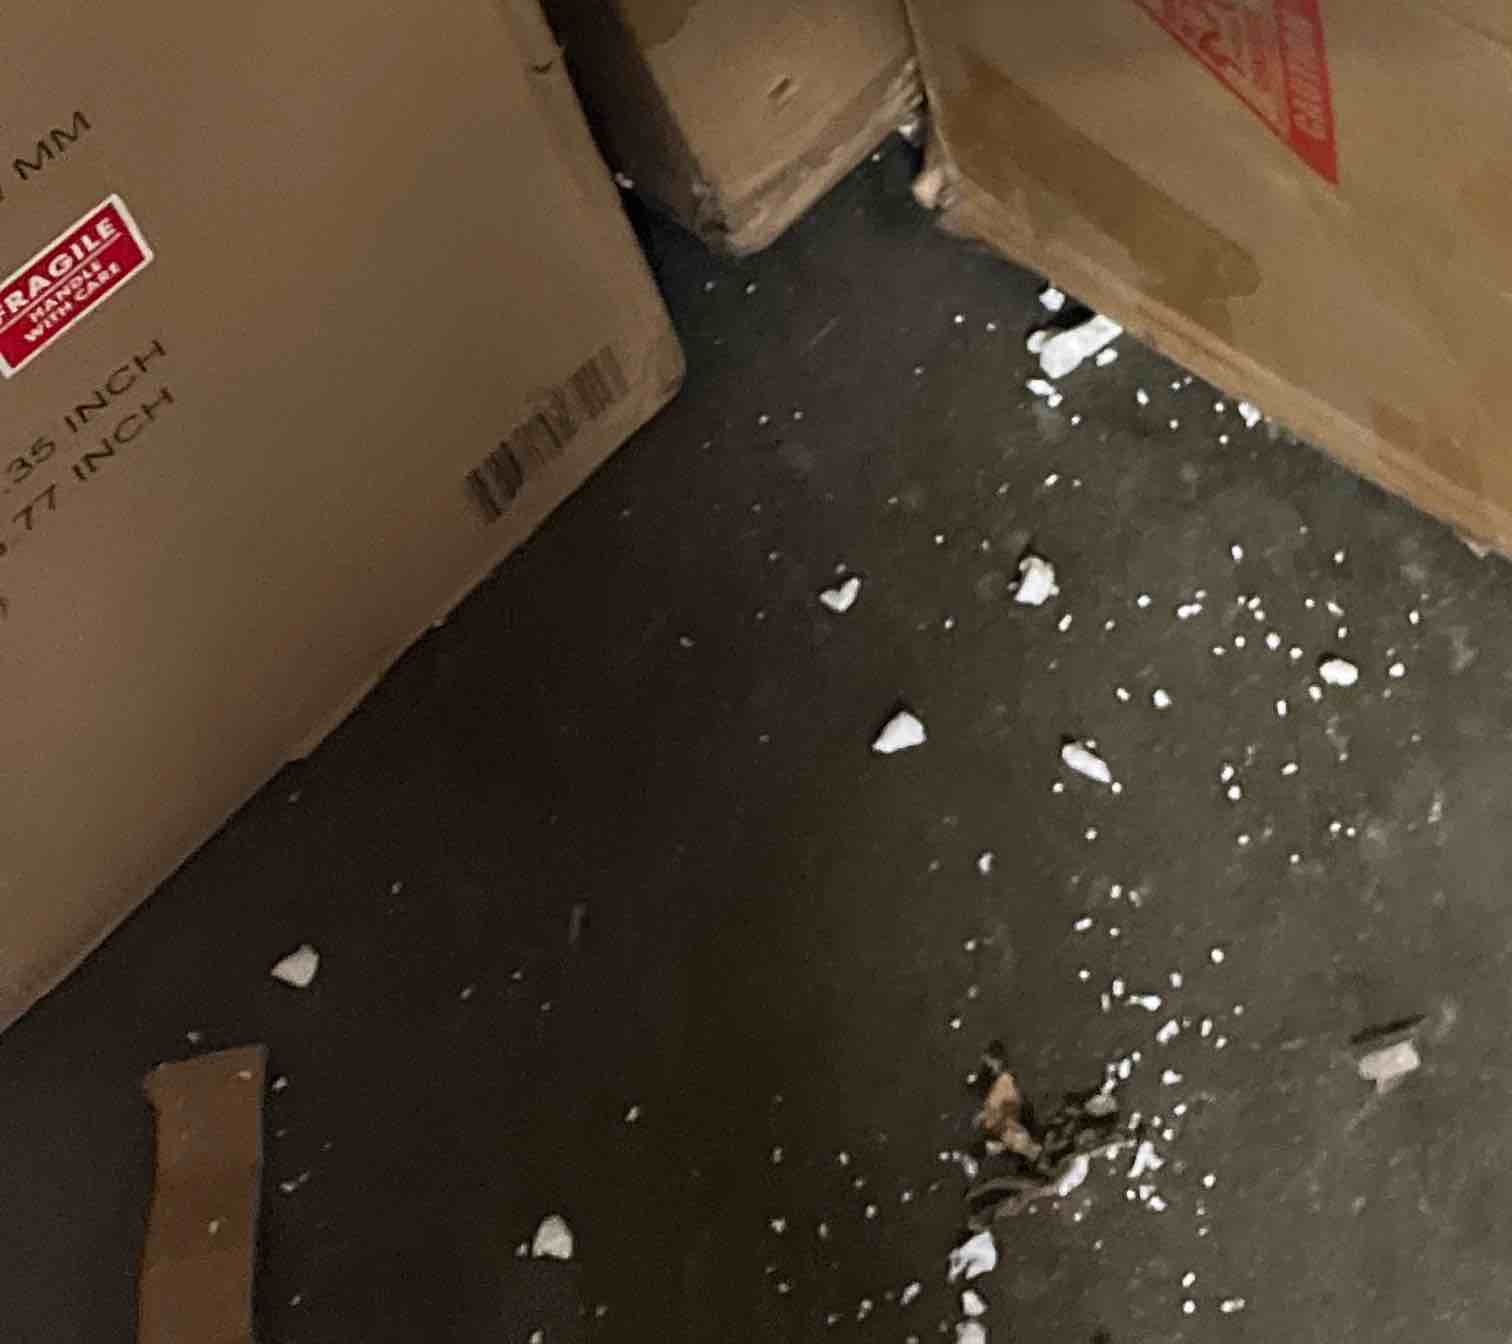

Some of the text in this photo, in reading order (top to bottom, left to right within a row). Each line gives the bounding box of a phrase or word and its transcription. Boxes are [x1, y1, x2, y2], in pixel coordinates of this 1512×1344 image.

[13, 111, 92, 180] MM
[0, 217, 118, 326] RAGILE
[23, 261, 121, 342] WITH CARE
[29, 259, 103, 323] HANDLE
[64, 339, 167, 433] INCH
[72, 386, 175, 481] INCH
